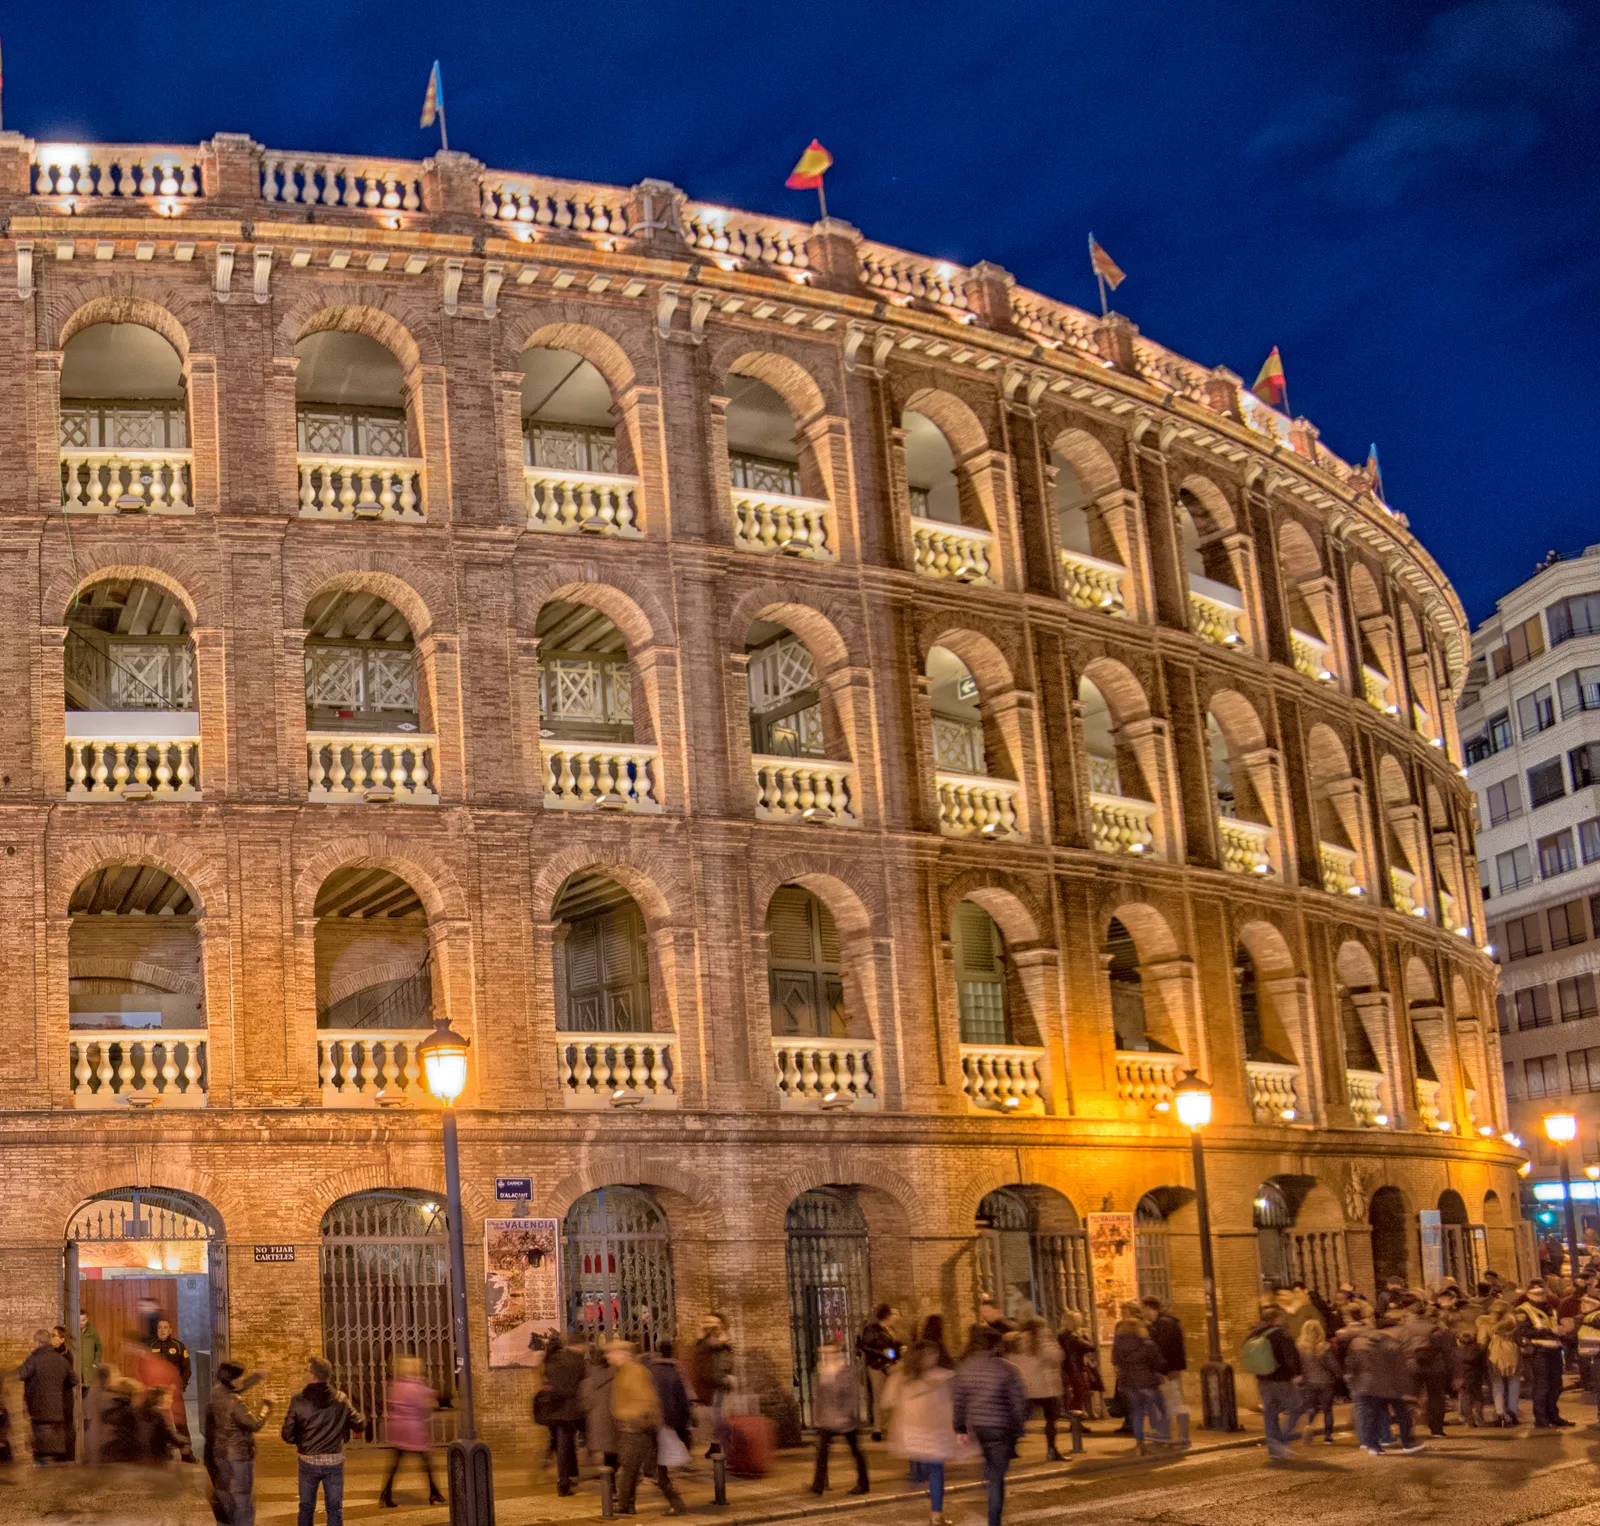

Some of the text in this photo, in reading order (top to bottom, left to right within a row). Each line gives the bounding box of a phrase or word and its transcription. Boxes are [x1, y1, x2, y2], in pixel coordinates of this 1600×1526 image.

[504, 1221, 555, 1229] VALENCIA
[255, 1246, 268, 1254] NO
[255, 1253, 294, 1261] CARTELES
